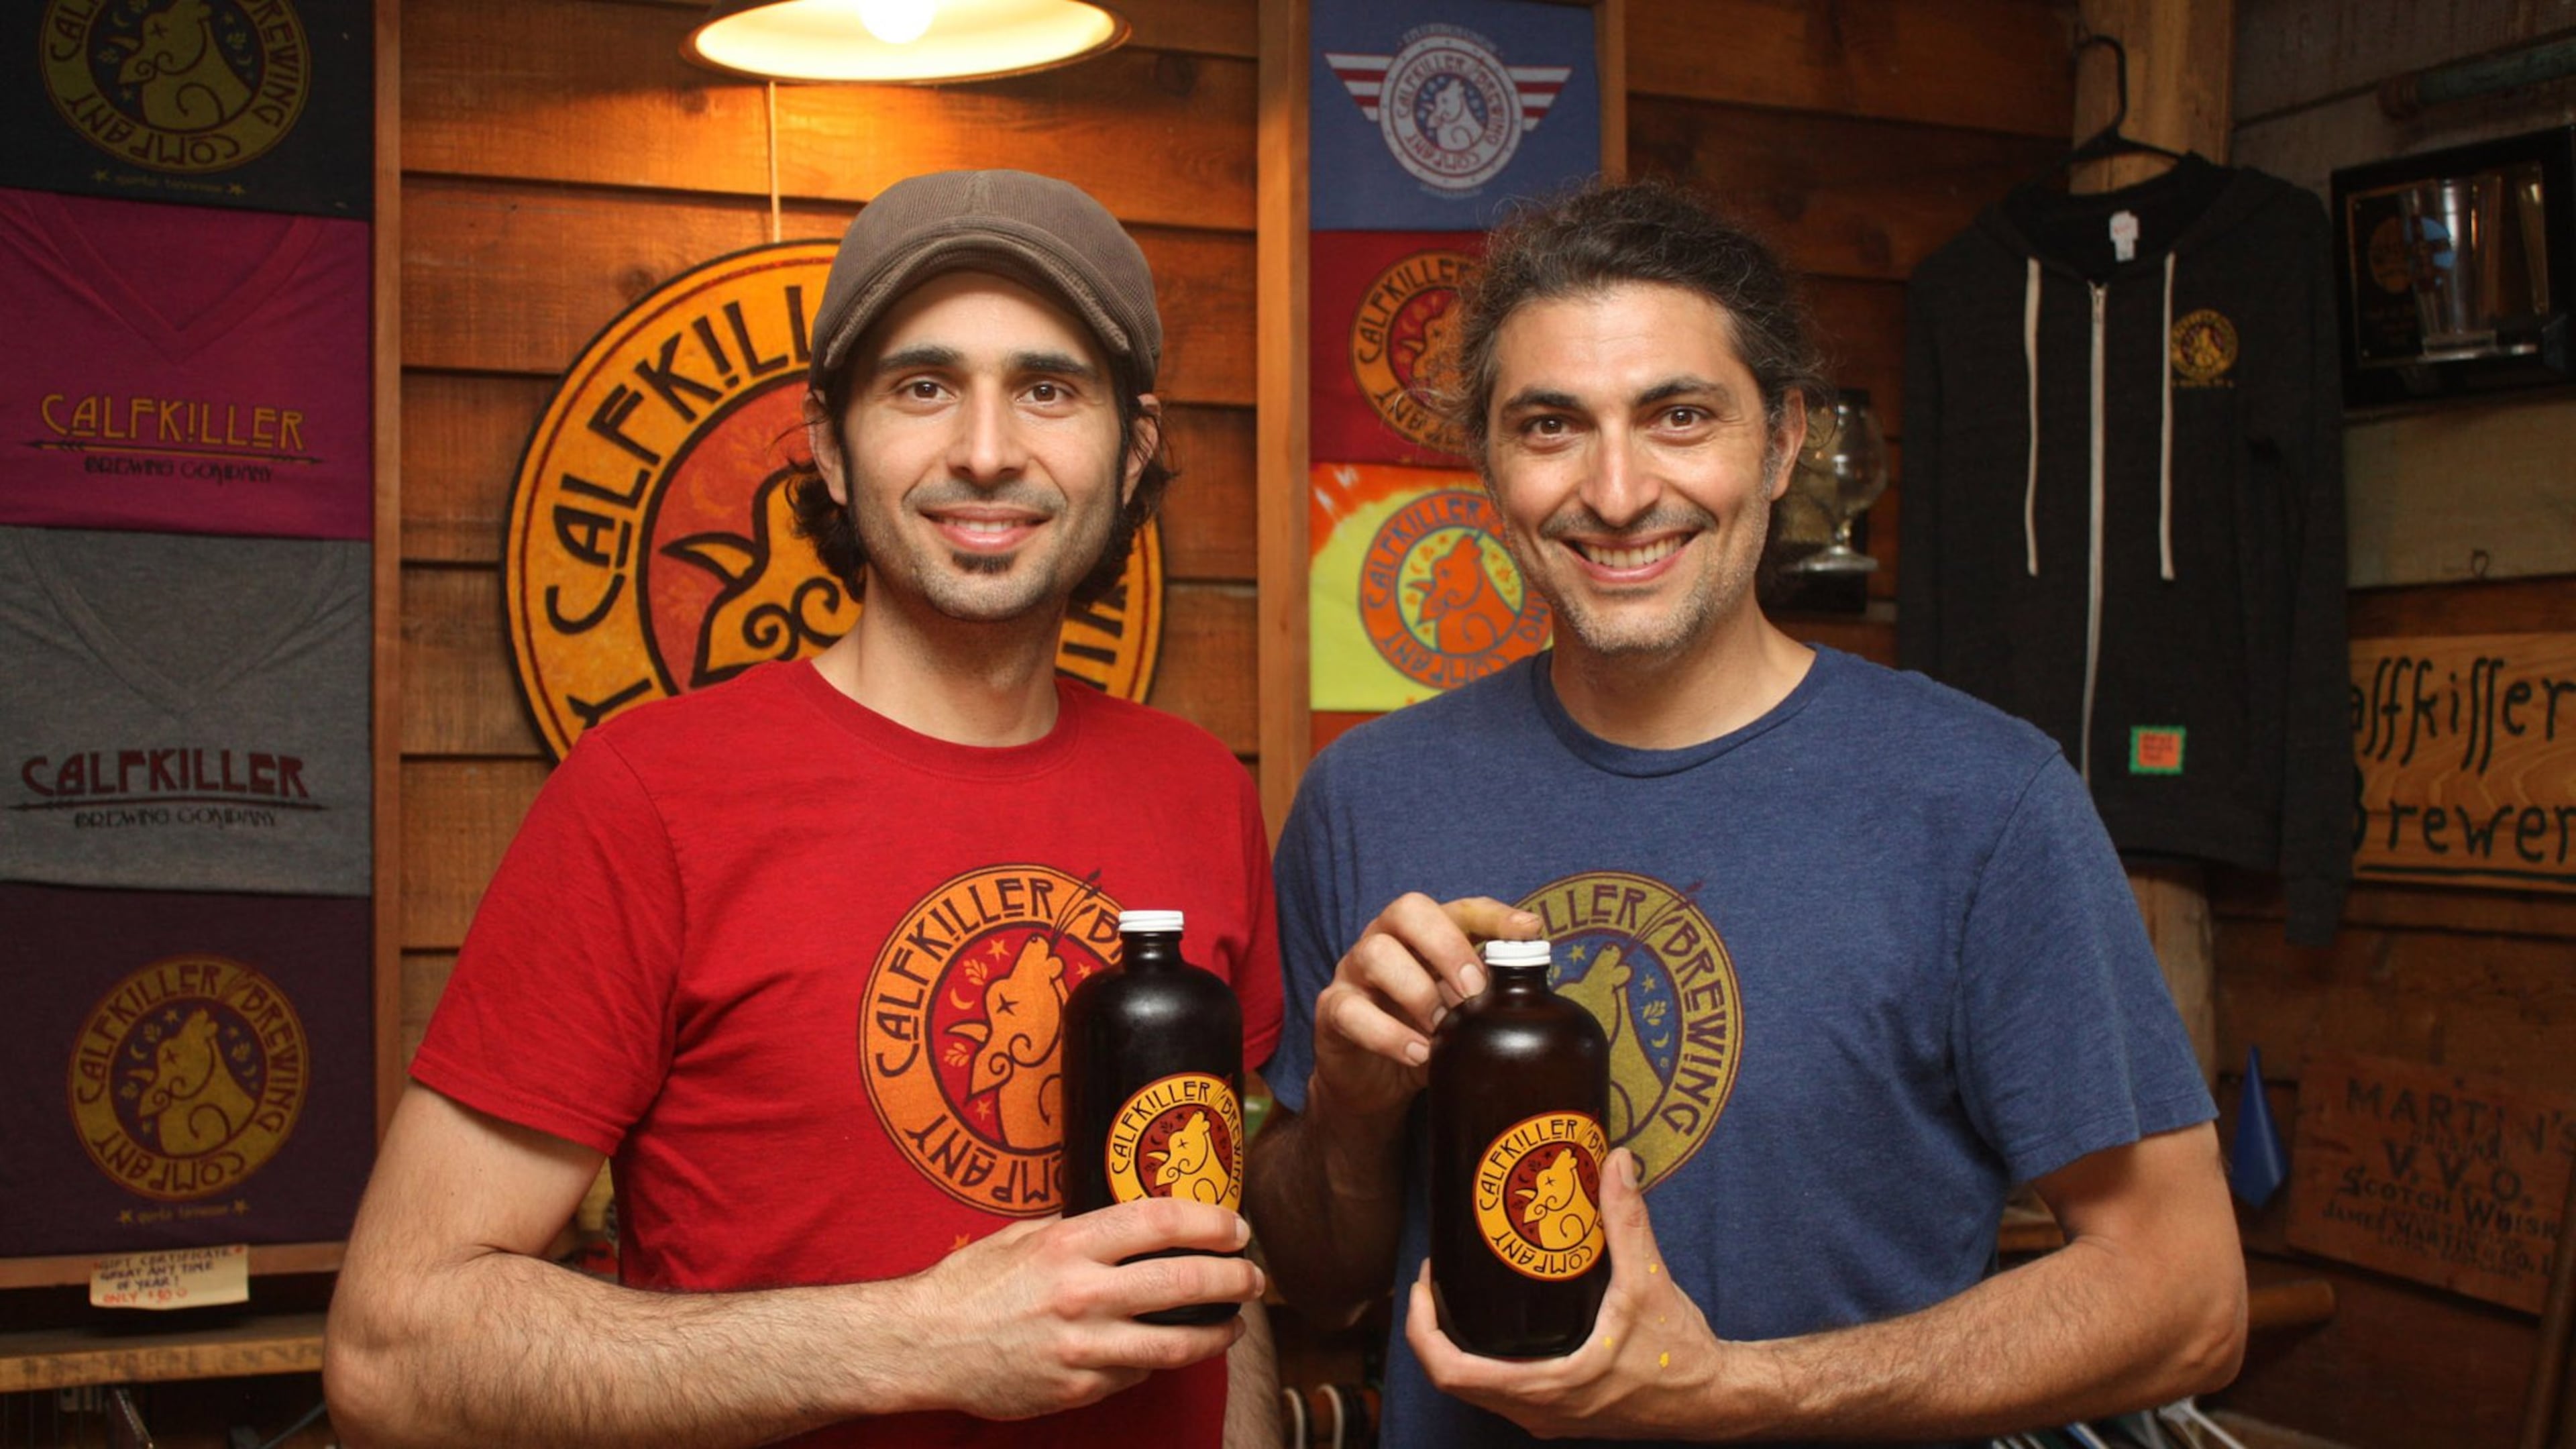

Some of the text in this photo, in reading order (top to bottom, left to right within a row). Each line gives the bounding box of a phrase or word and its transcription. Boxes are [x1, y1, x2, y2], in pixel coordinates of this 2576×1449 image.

[248, 0, 301, 127] REWING
[64, 91, 241, 164] COMPANY
[42, 393, 304, 451] CALFKILLER
[544, 285, 813, 635] CALFKILL
[85, 456, 272, 484] BREWING COMPANY
[1367, 497, 1481, 609] CALFKILLER
[21, 749, 309, 799] CALFKILLER
[74, 808, 276, 829] BREWING COMPANY
[876, 877, 1055, 1078] CALFKILLER
[77, 964, 222, 1105] CALFKILLER
[240, 982, 301, 1134] BREWING
[1660, 919, 1727, 1136] BREWING
[91, 1131, 244, 1191] COMPANY
[1111, 1081, 1212, 1175] CALFKILLER
[1479, 1119, 1578, 1211] CALFKILLER
[1491, 1231, 1593, 1274] COMPANY
